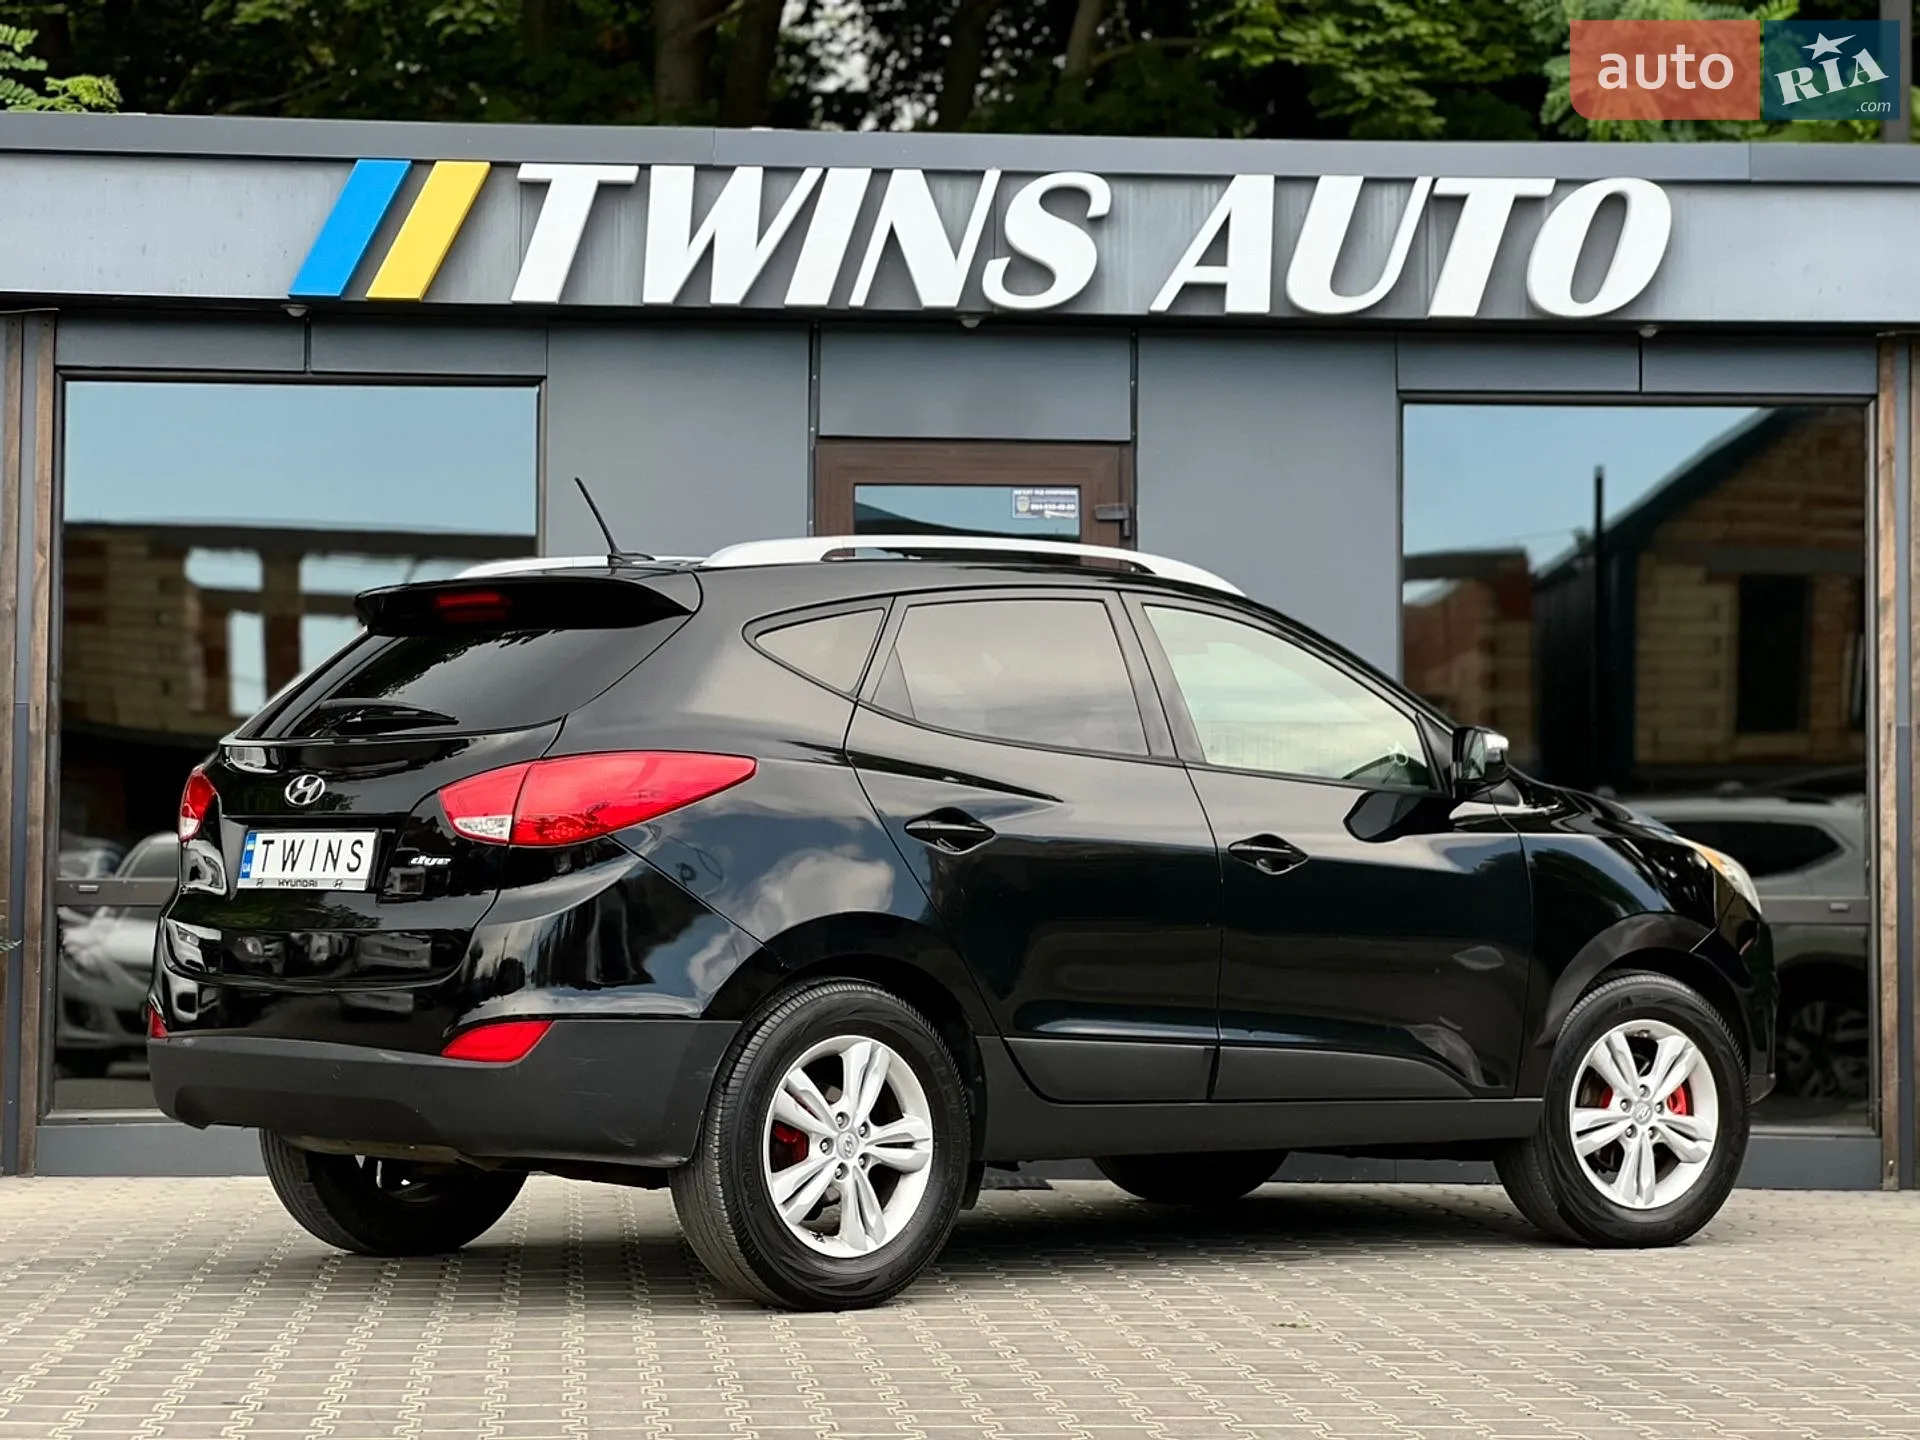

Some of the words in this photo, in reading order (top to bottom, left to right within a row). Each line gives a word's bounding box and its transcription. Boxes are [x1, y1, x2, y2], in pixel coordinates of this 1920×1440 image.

[511, 163, 1112, 311] TWINS
[1149, 174, 1672, 318] AUTO
[261, 838, 364, 873] TWINS
